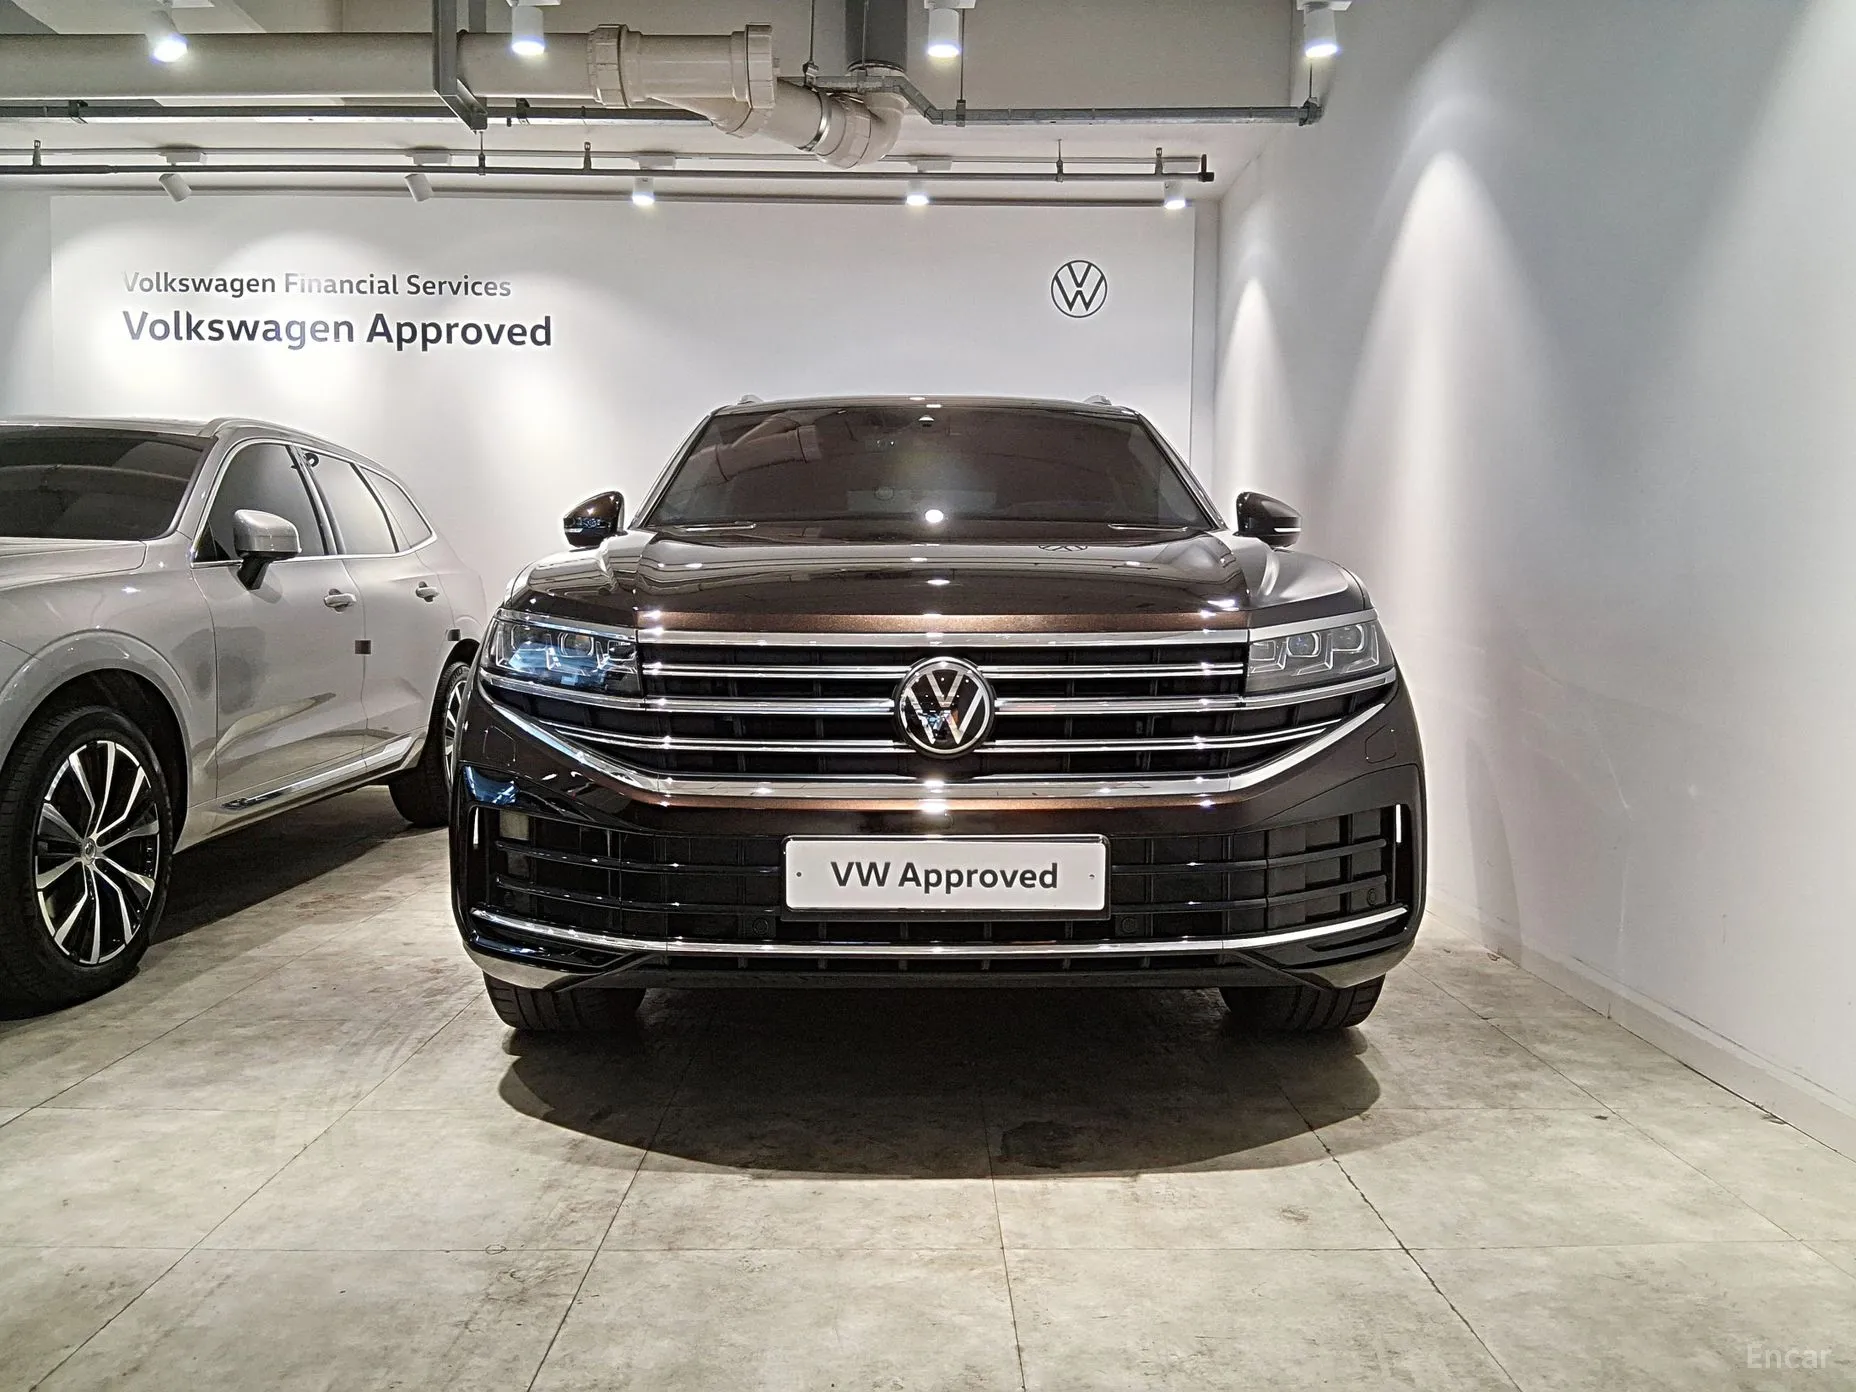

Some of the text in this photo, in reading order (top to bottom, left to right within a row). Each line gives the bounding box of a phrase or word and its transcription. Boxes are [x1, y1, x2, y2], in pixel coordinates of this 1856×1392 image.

[124, 271, 511, 298] Volkswagen Financial Services
[122, 310, 551, 351] Volkswagen Approved
[830, 861, 1058, 894] VW Approved
